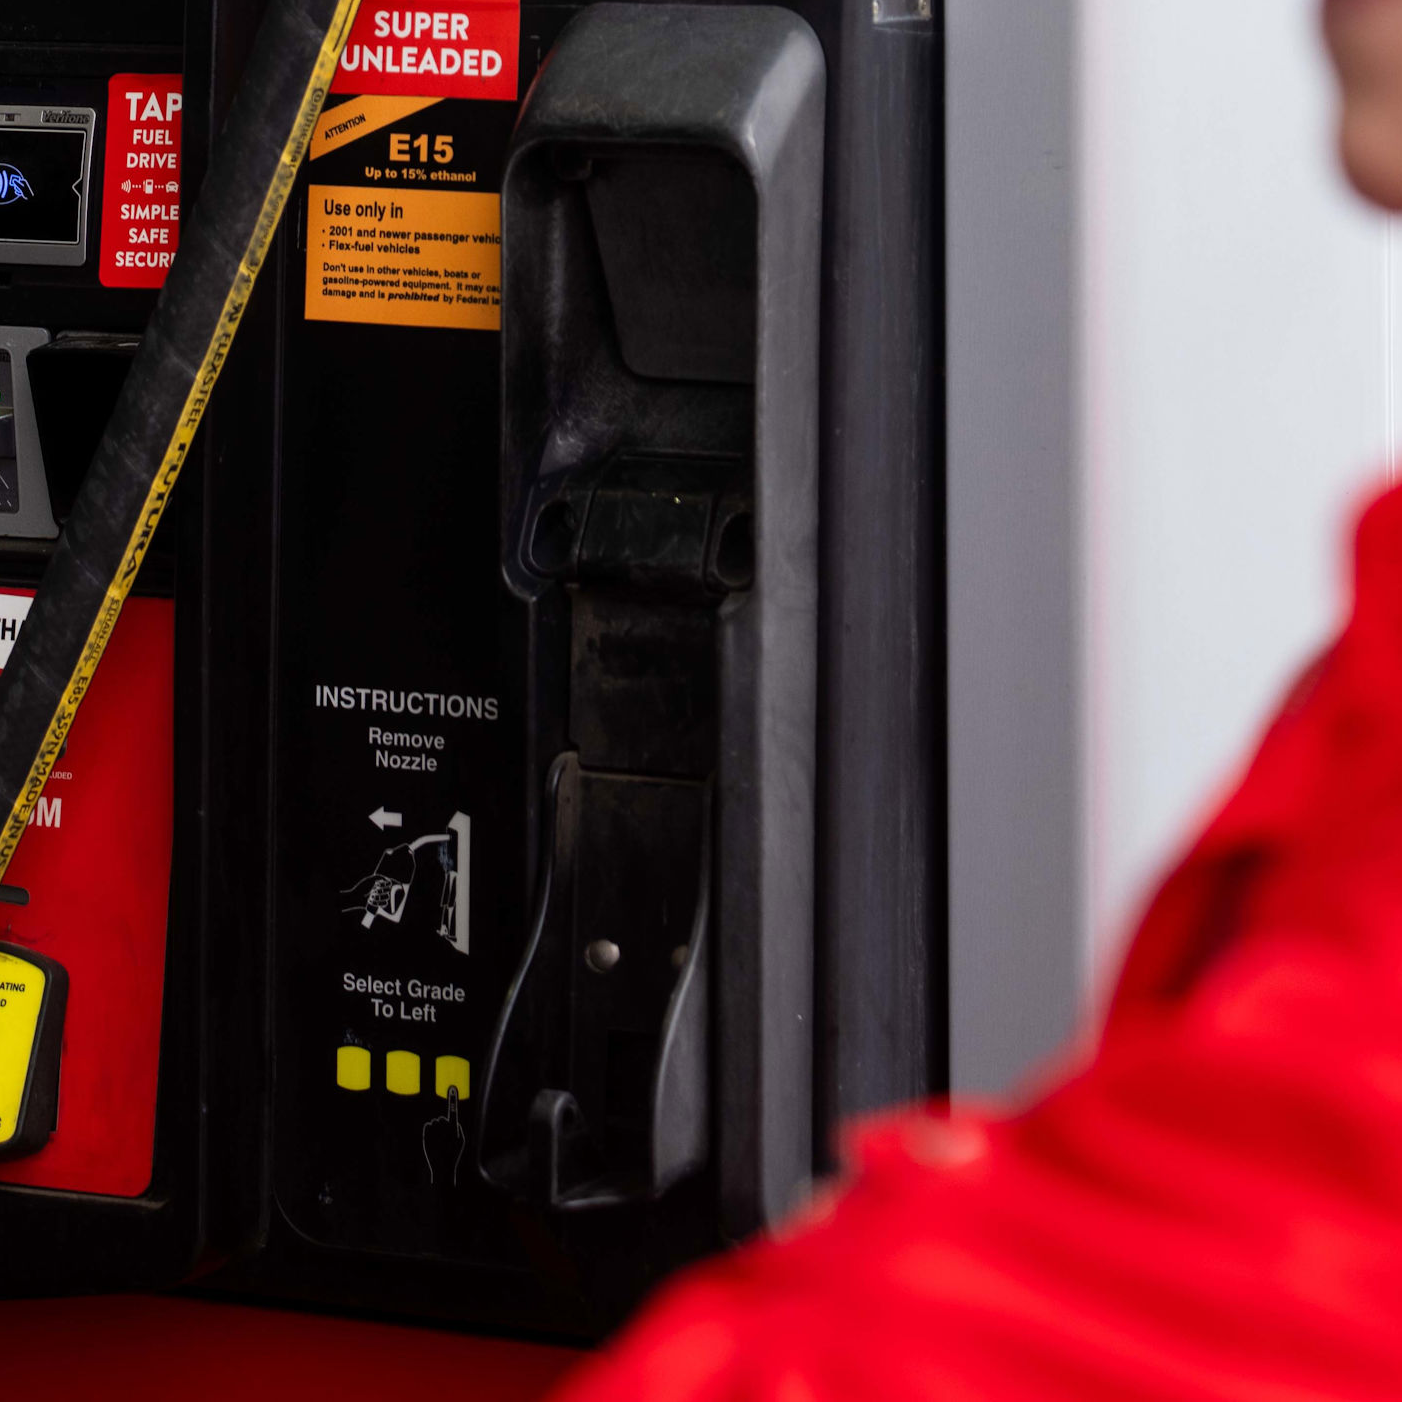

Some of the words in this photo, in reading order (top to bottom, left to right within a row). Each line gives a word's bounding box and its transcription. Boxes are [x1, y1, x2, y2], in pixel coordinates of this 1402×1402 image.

[374, 10, 469, 40] SUPER
[341, 44, 502, 77] UNLEADED
[42, 110, 91, 124] Verifone
[126, 92, 182, 121] TAP
[132, 129, 173, 146] FUEL
[325, 113, 365, 140] ATTENTION
[389, 133, 454, 164] E15
[126, 152, 177, 169] DRIVE
[365, 167, 381, 180] Up
[385, 168, 397, 179] to
[401, 169, 427, 179] 15%
[430, 170, 476, 182] ethanol
[120, 203, 178, 221] SIMPLE
[324, 199, 350, 216] Use
[355, 201, 385, 222] only
[390, 202, 403, 218] in
[128, 227, 169, 244] SAFE
[329, 226, 353, 236] 2001
[356, 228, 375, 238] and
[379, 230, 411, 240] newer
[414, 231, 469, 244] passenger
[329, 240, 374, 252] Flex-fuel
[377, 244, 420, 254] vehicles
[315, 685, 498, 720] INSTRUCTIONS
[369, 727, 445, 750] Remove
[375, 751, 438, 771] Nozzle
[342, 973, 402, 997] Select
[407, 979, 465, 1002] Grade
[371, 998, 393, 1018] To
[400, 1001, 436, 1023] Left
